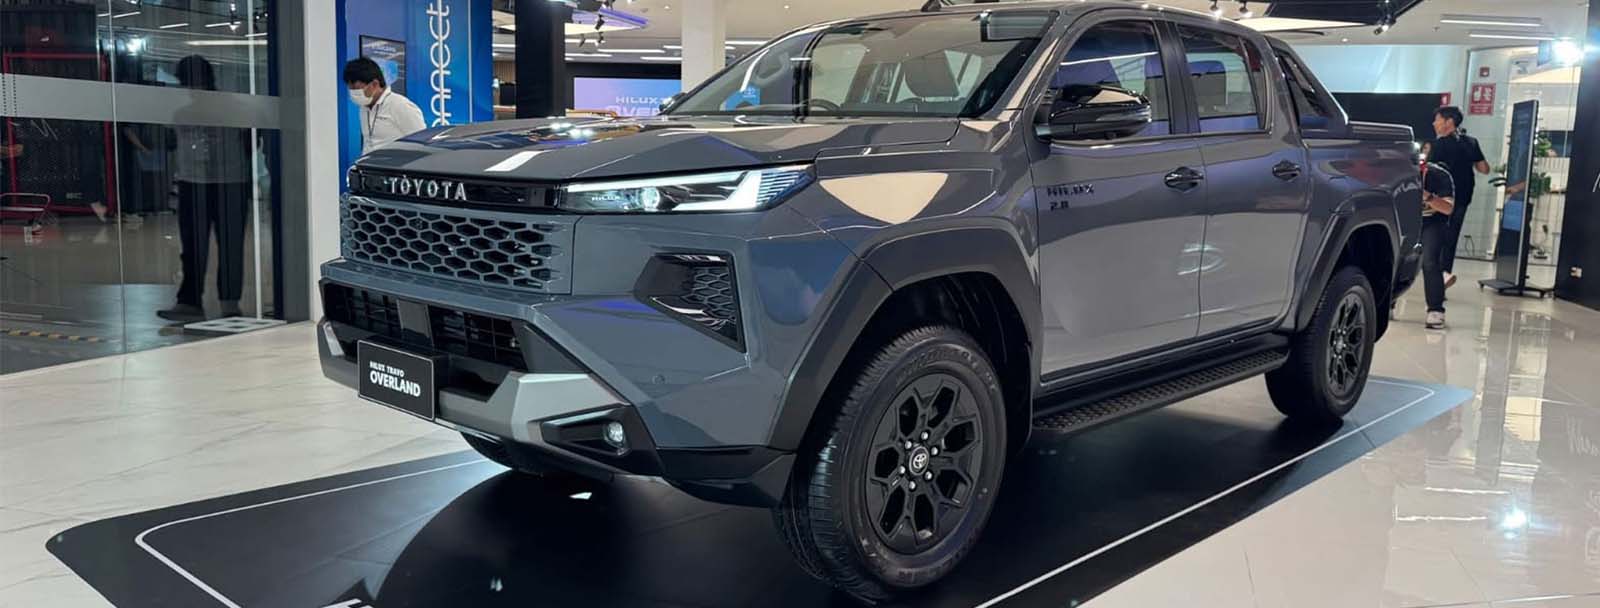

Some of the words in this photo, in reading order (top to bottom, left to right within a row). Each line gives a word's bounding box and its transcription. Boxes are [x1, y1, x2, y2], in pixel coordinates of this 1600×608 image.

[388, 177, 467, 201] TOYOTA
[1047, 184, 1095, 197] HILUX
[369, 361, 385, 372] HILUX
[386, 366, 405, 377] TRAVO
[370, 370, 421, 397] OVERLAND
